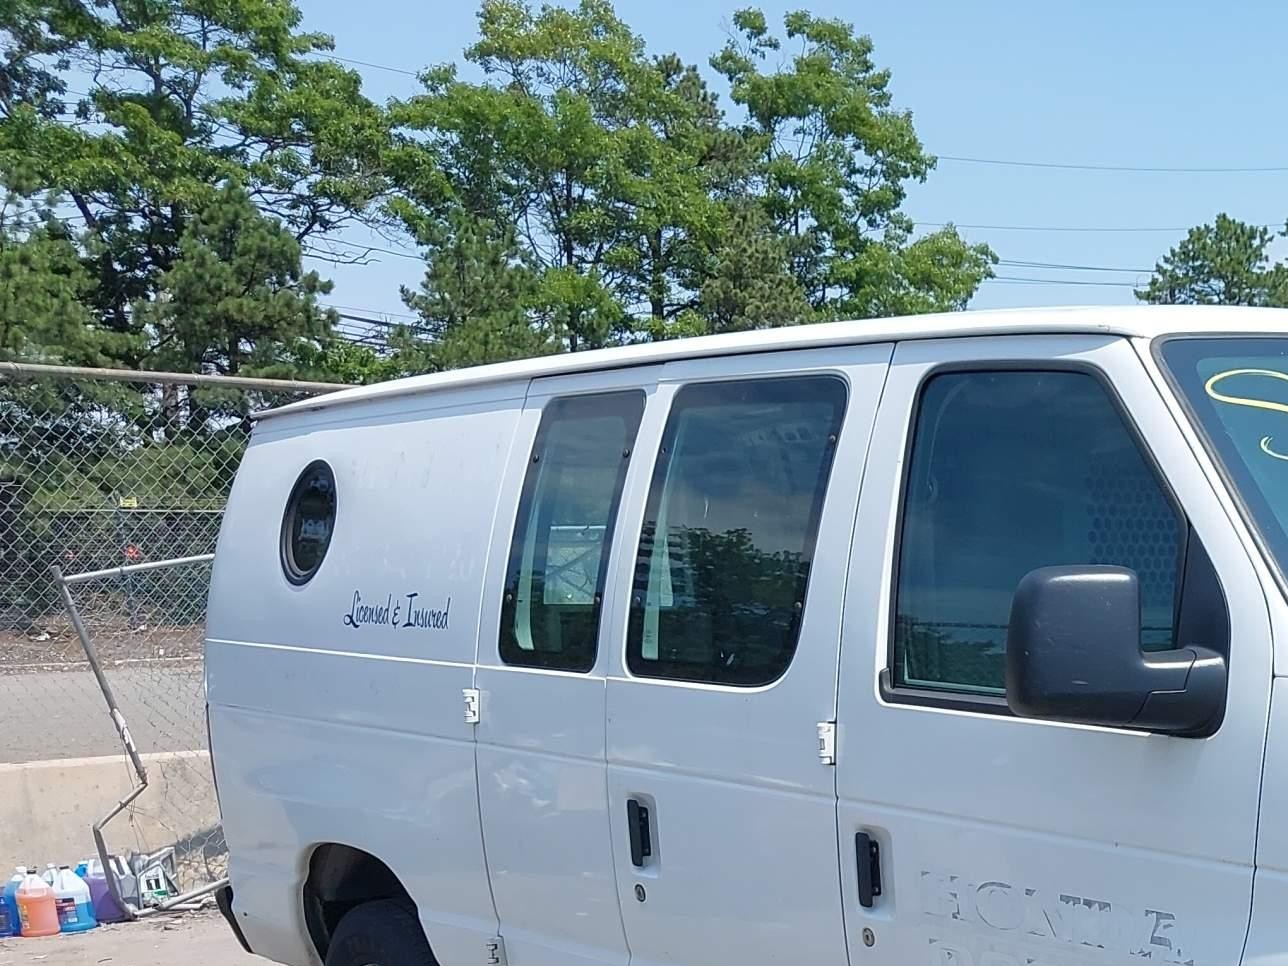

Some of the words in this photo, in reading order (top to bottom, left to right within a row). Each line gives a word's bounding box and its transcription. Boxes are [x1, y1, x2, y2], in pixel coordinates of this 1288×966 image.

[343, 590, 392, 628] Licensed
[391, 599, 401, 629] &
[402, 592, 451, 630] Insured
